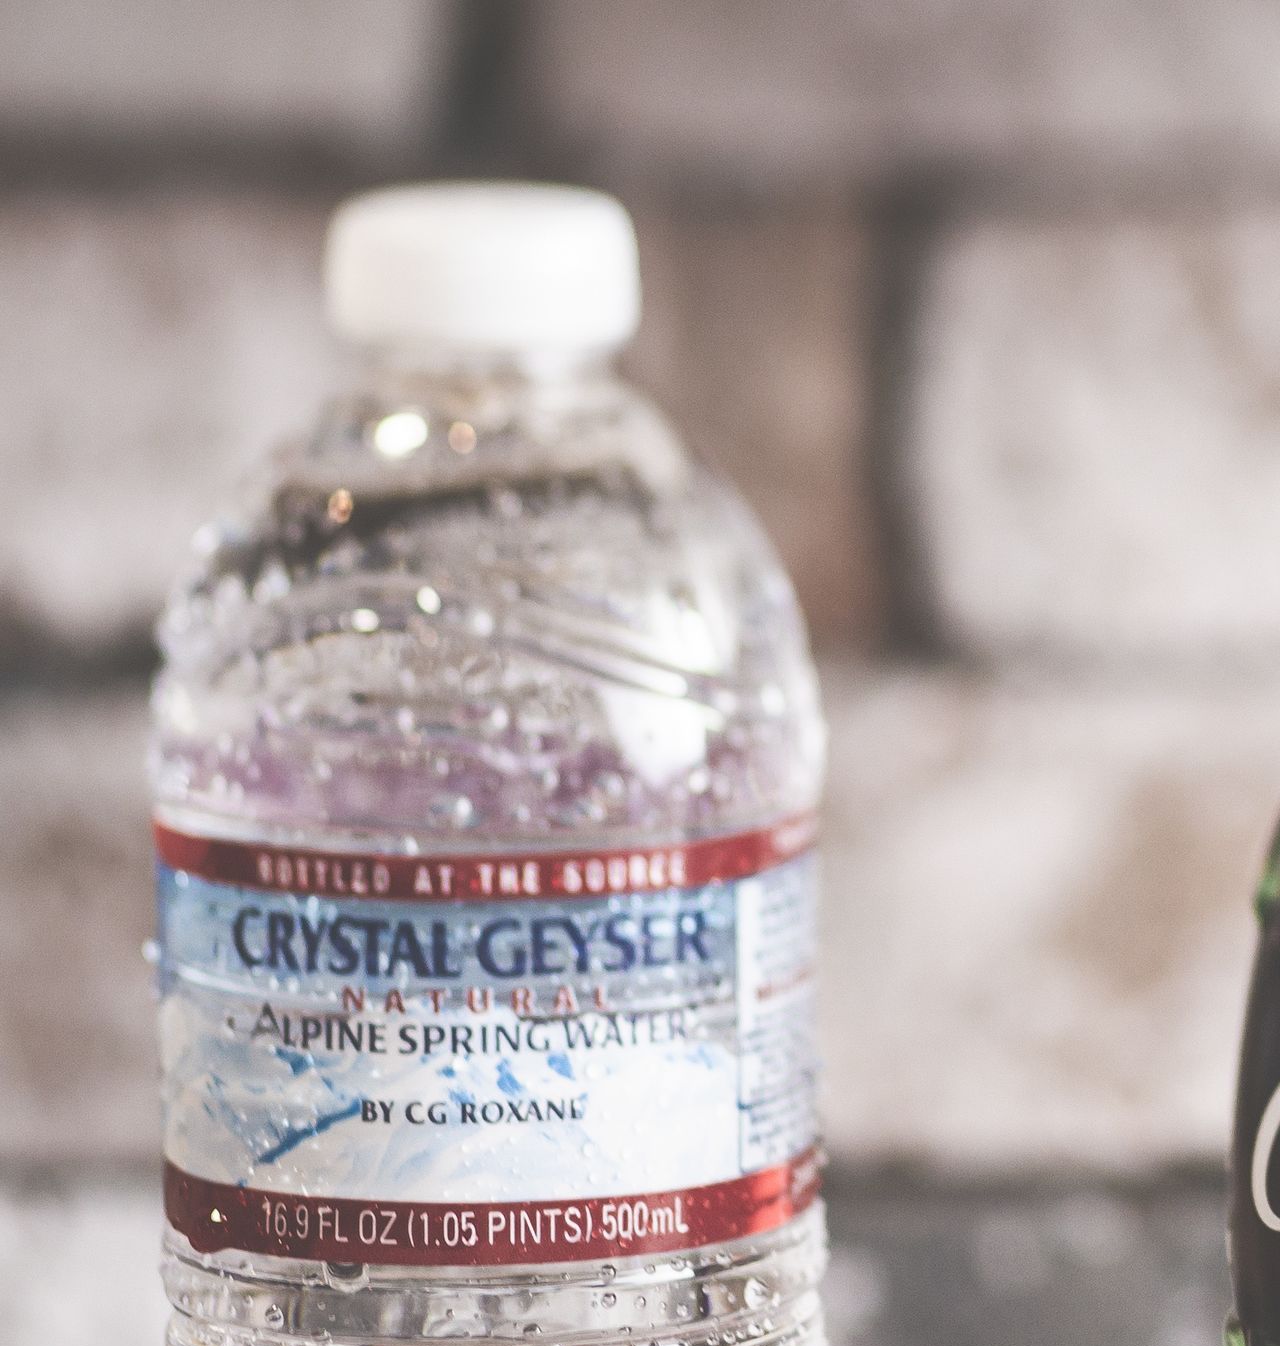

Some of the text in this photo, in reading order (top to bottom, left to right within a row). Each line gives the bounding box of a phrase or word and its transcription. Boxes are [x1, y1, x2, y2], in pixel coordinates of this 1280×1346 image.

[256, 849, 688, 895] BOTTLED AT THE SOURCE
[231, 906, 709, 980] CRYSTAL GEYSER
[340, 984, 611, 1015] NATURAL
[252, 1002, 688, 1055] ALPINE SPRING WATER
[360, 1099, 395, 1125] BY
[405, 1101, 448, 1125] CG
[262, 1196, 310, 1240] 16.9
[317, 1204, 349, 1244] FL
[358, 1208, 399, 1247] OZ
[407, 1208, 479, 1249] (1.05
[488, 1204, 593, 1247] PINTS)
